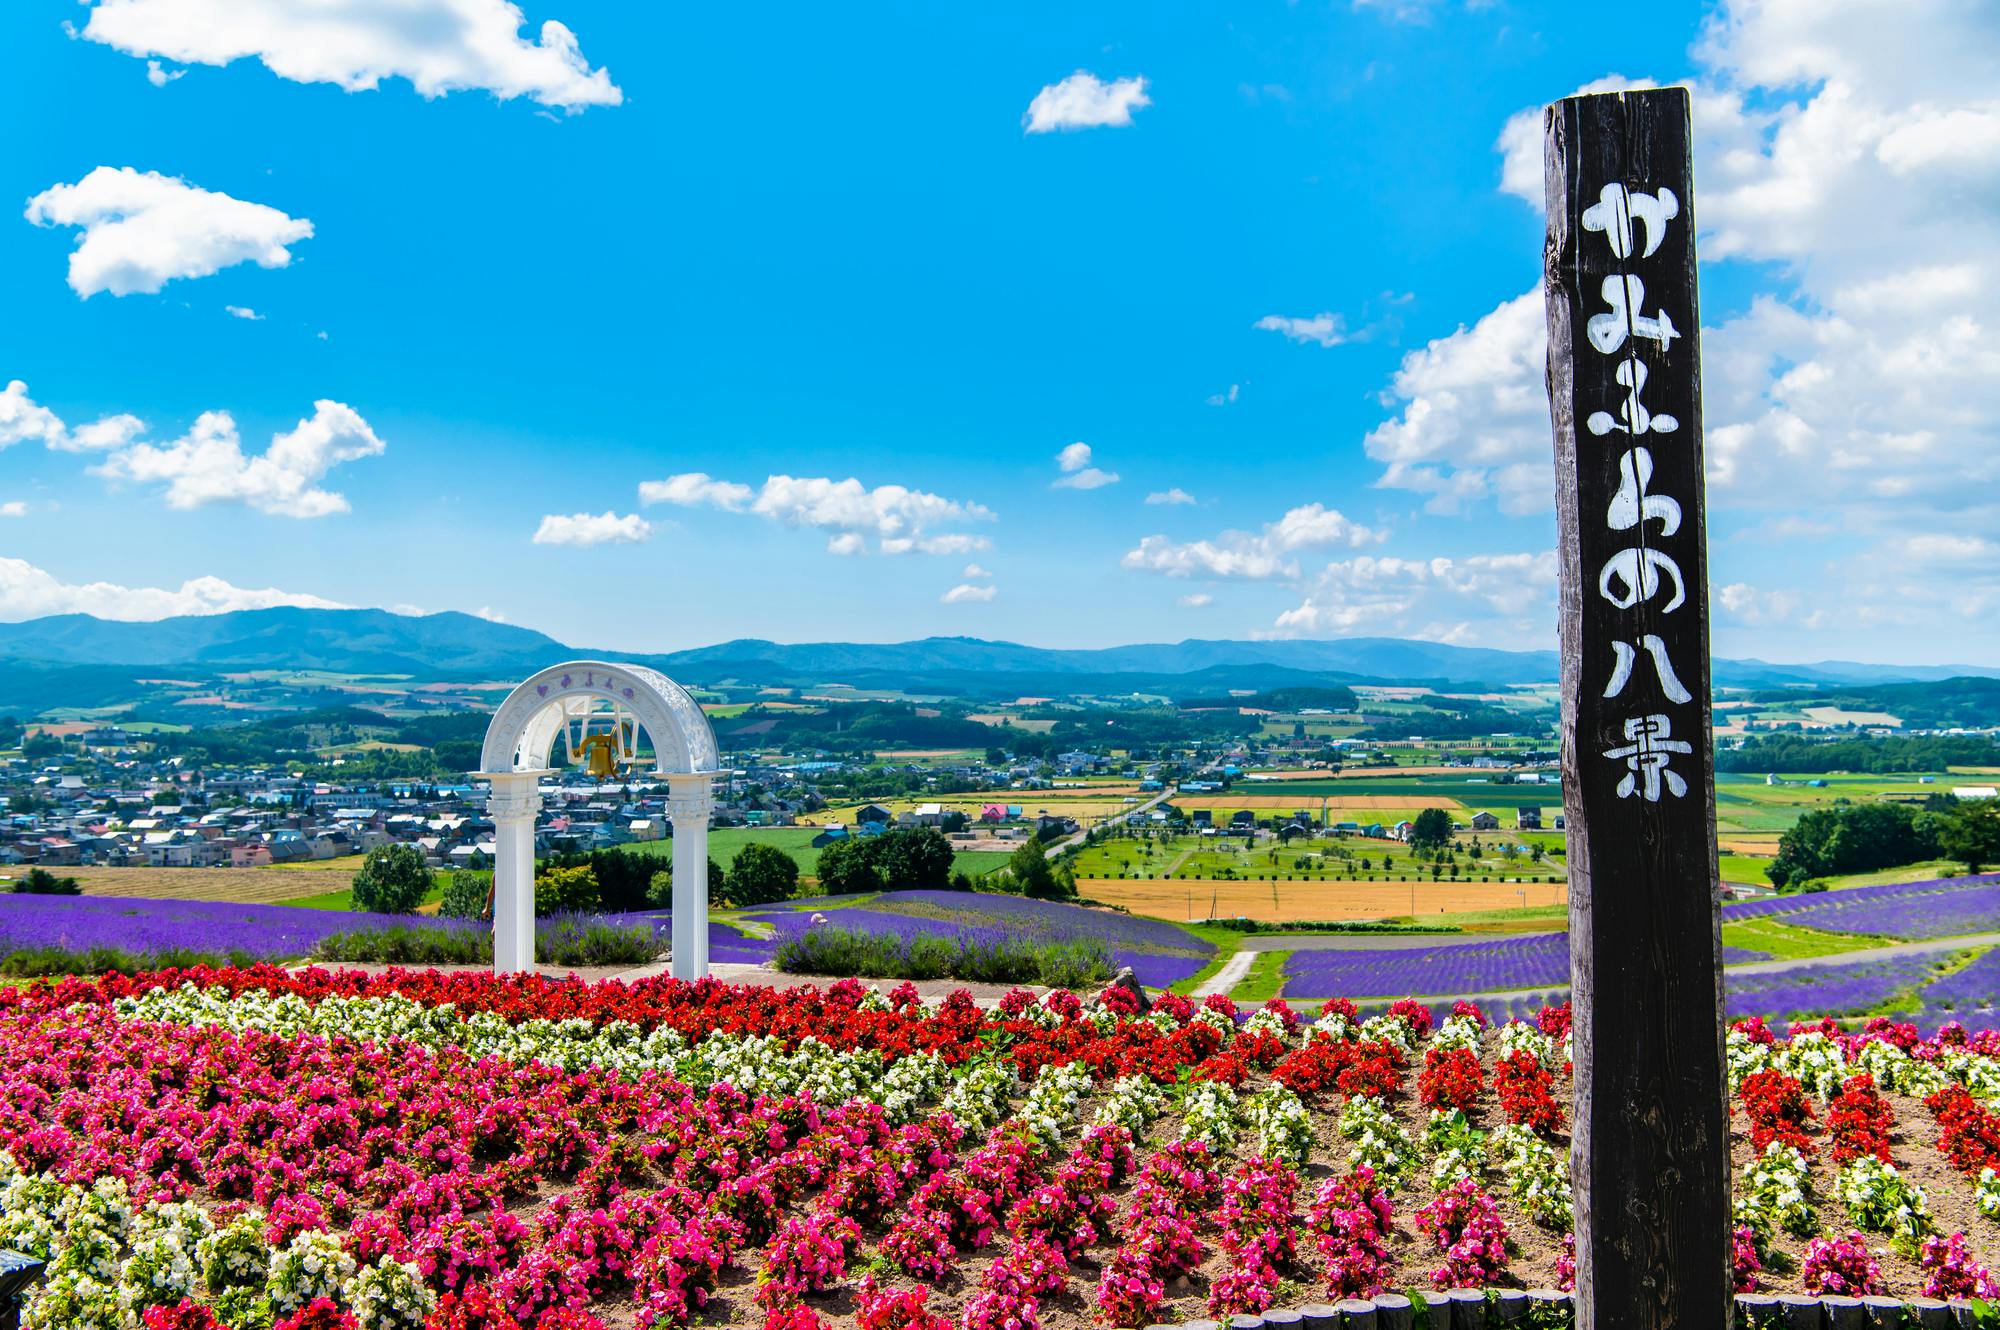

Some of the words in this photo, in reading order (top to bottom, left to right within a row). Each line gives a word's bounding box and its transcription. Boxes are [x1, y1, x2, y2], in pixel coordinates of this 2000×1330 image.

[1581, 182, 1693, 801] かみふらの八景
